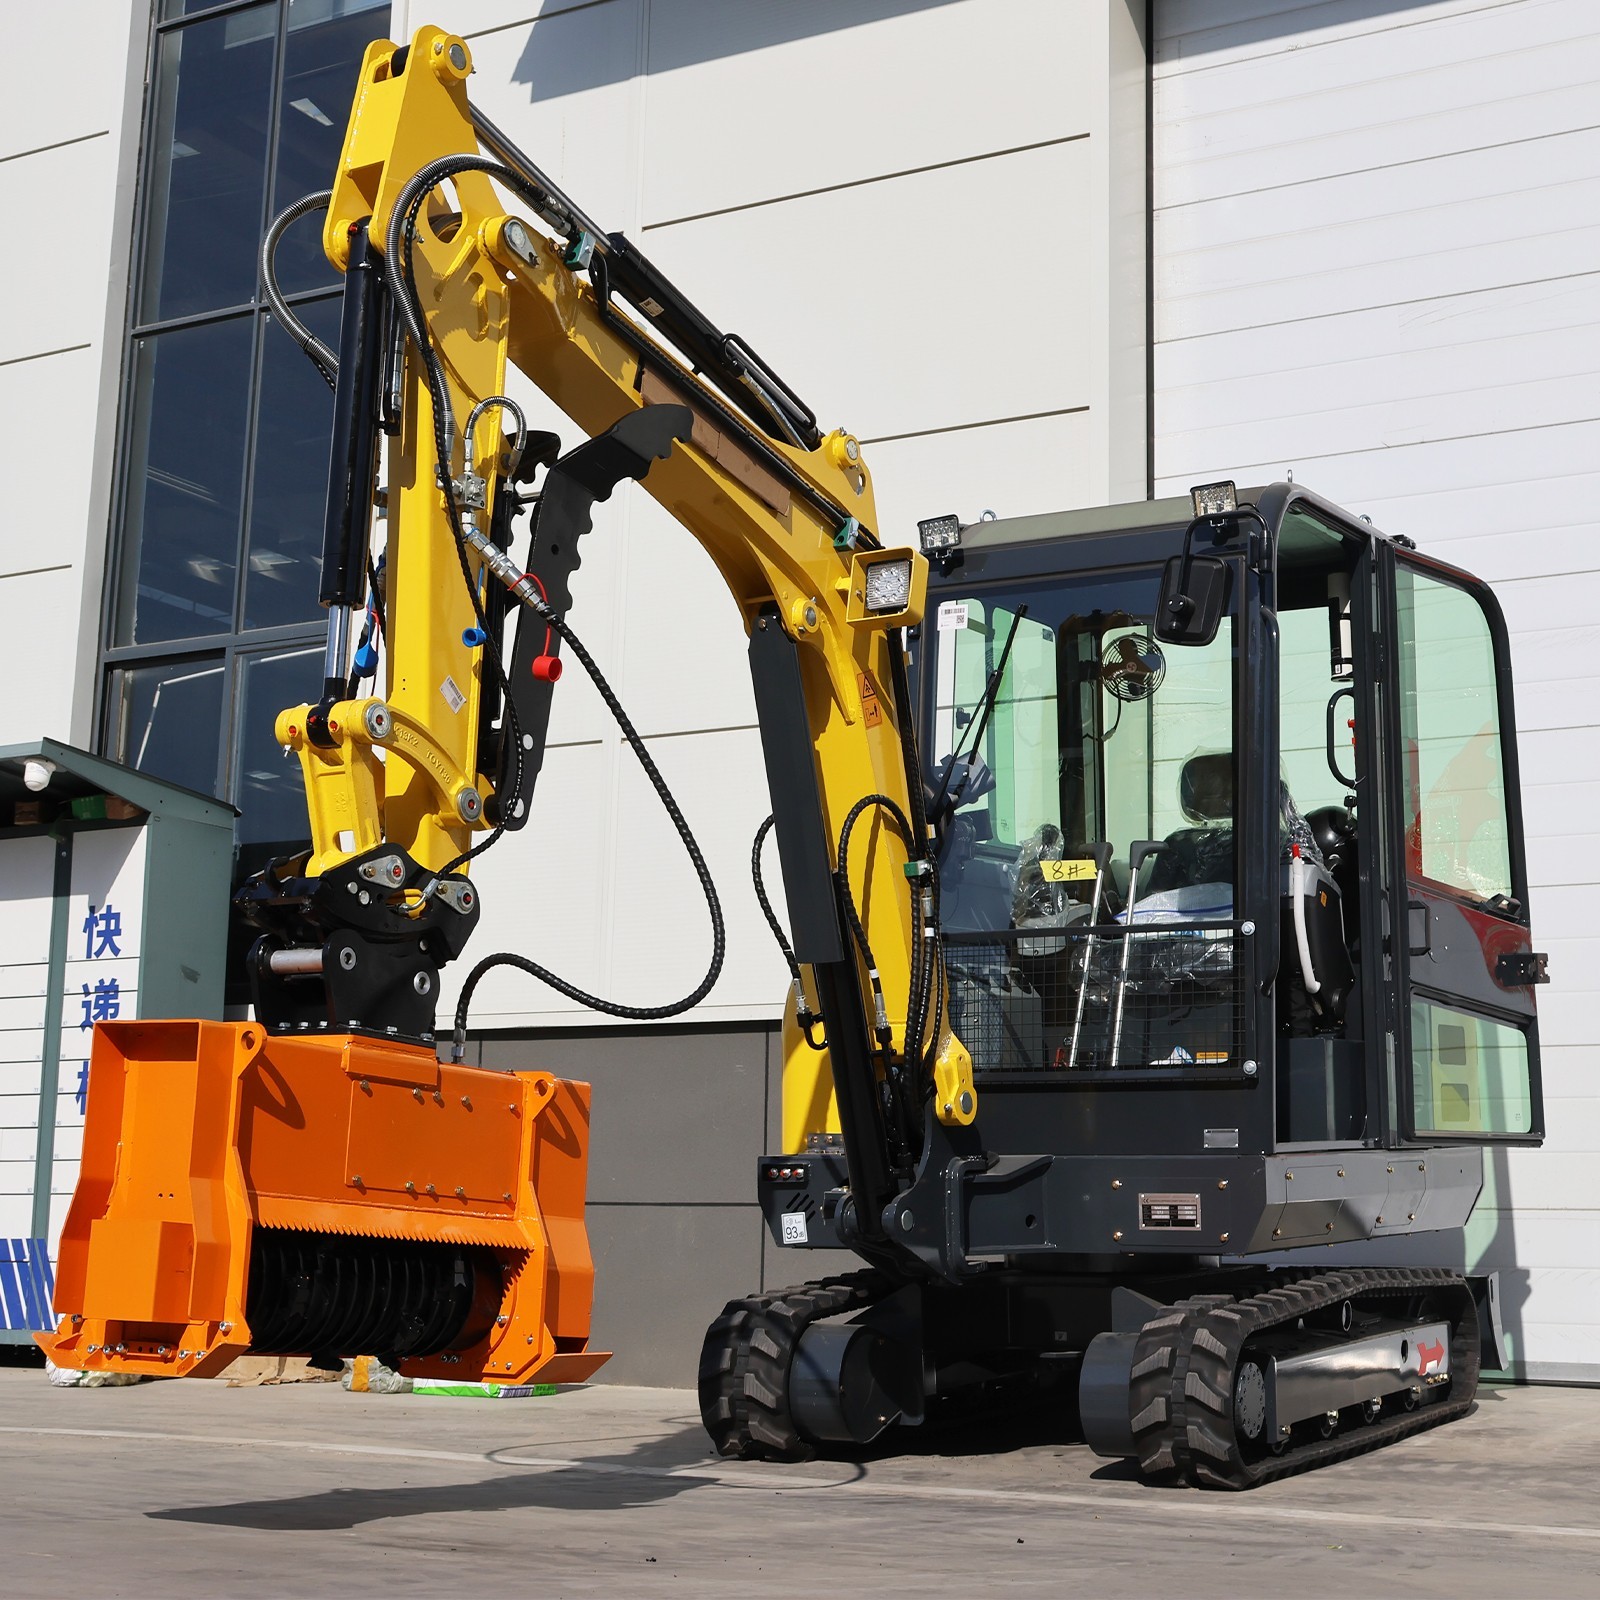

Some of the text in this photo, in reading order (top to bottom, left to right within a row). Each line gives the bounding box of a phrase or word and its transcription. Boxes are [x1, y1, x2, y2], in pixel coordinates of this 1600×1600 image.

[1052, 860, 1086, 880] 8#
[75, 904, 122, 1116] 快递
[786, 1226, 798, 1240] 93
